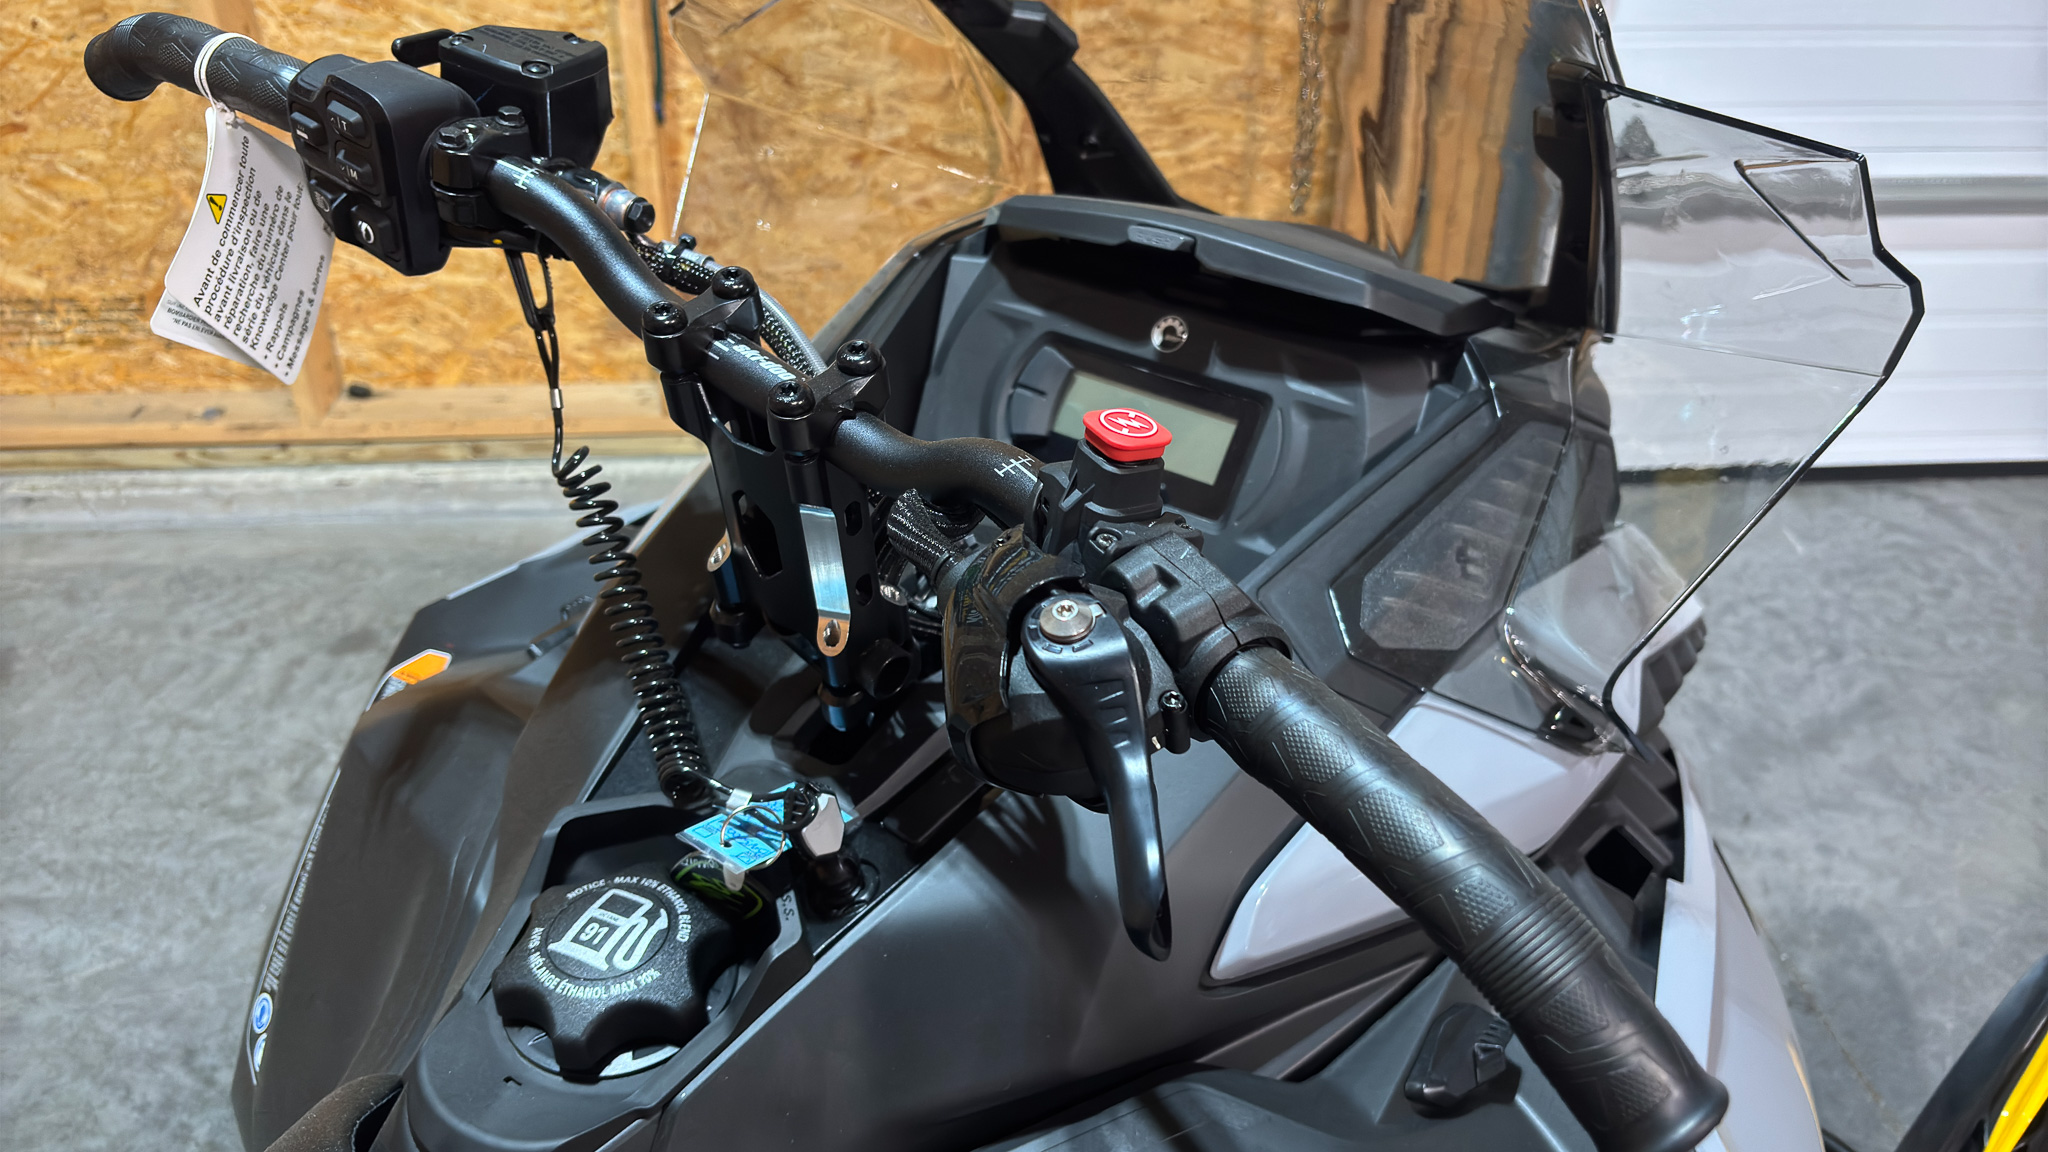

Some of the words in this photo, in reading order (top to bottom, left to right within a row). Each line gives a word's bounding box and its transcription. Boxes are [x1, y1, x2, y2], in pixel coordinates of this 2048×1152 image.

[341, 120, 347, 131] T
[350, 169, 358, 181] M
[284, 191, 293, 204] le
[193, 267, 215, 307] Avant
[212, 249, 222, 266] de
[219, 170, 245, 247] commencer
[239, 135, 250, 168] toute
[204, 249, 234, 316] procédure
[231, 167, 257, 246] d'inspection
[279, 205, 290, 236] dans
[214, 284, 234, 323] avant
[228, 229, 253, 285] livraison
[249, 209, 258, 226] ou
[255, 190, 262, 207] de
[223, 262, 254, 330] réparation,
[250, 229, 263, 258] faire
[260, 203, 270, 228] une
[233, 273, 260, 337] recherche
[257, 254, 266, 271] du
[263, 203, 280, 249] numéro
[276, 185, 284, 201] de
[261, 237, 281, 290] véhicule
[250, 284, 278, 351] Knowledge
[274, 242, 290, 281] Center
[287, 211, 299, 243] pour
[255, 292, 265, 310] du
[242, 312, 258, 344] série
[265, 302, 288, 353] Rappels
[277, 289, 305, 361] Campagnes
[287, 310, 312, 370] Messages
[312, 254, 325, 296] alertes
[566, 879, 605, 900] NOTICE
[613, 876, 640, 884] MAX
[641, 877, 658, 888] 10%
[656, 884, 689, 915] ETHANOL
[676, 914, 692, 942] BLEND
[528, 927, 545, 949] AVIS
[579, 922, 610, 945] 91
[527, 952, 560, 988] MÉLANGE
[559, 979, 608, 999] ÉTHANOL
[610, 979, 638, 996] MAX
